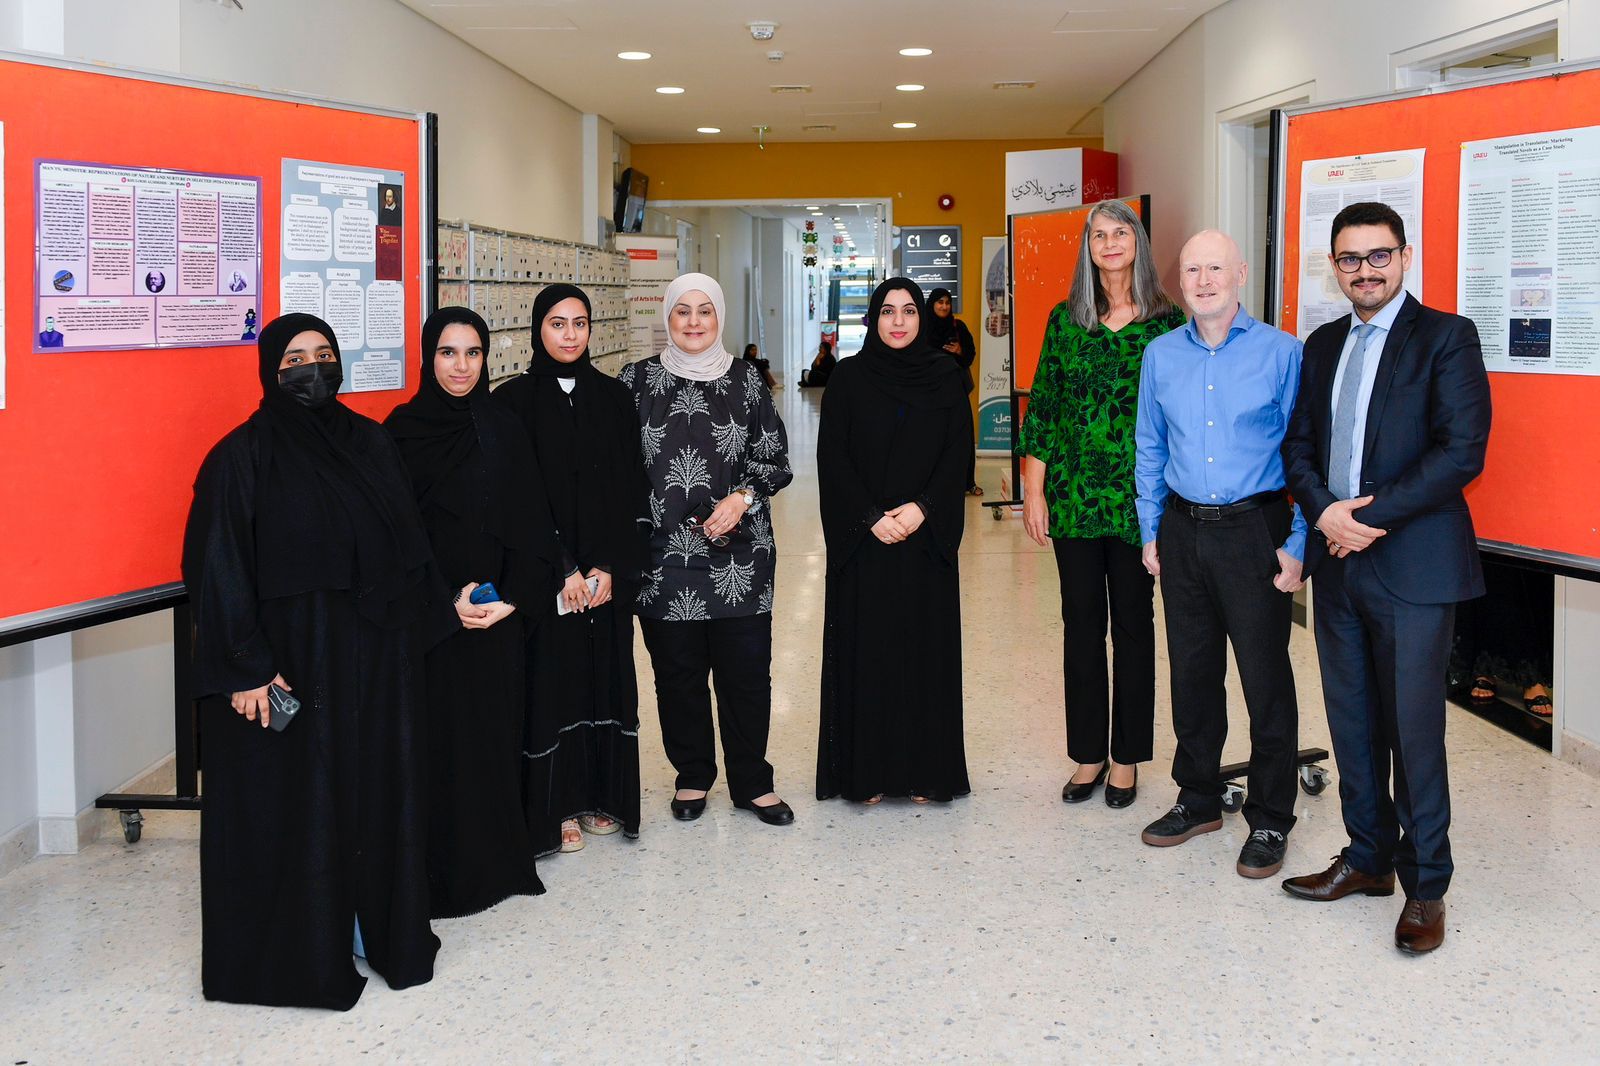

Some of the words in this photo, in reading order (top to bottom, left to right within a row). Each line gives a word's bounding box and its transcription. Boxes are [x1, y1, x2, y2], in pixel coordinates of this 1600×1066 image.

[1012, 180, 1044, 200] بلادي
[1045, 182, 1077, 203] عيشي
[907, 235, 920, 247] C1
[984, 372, 1008, 384] Spring
